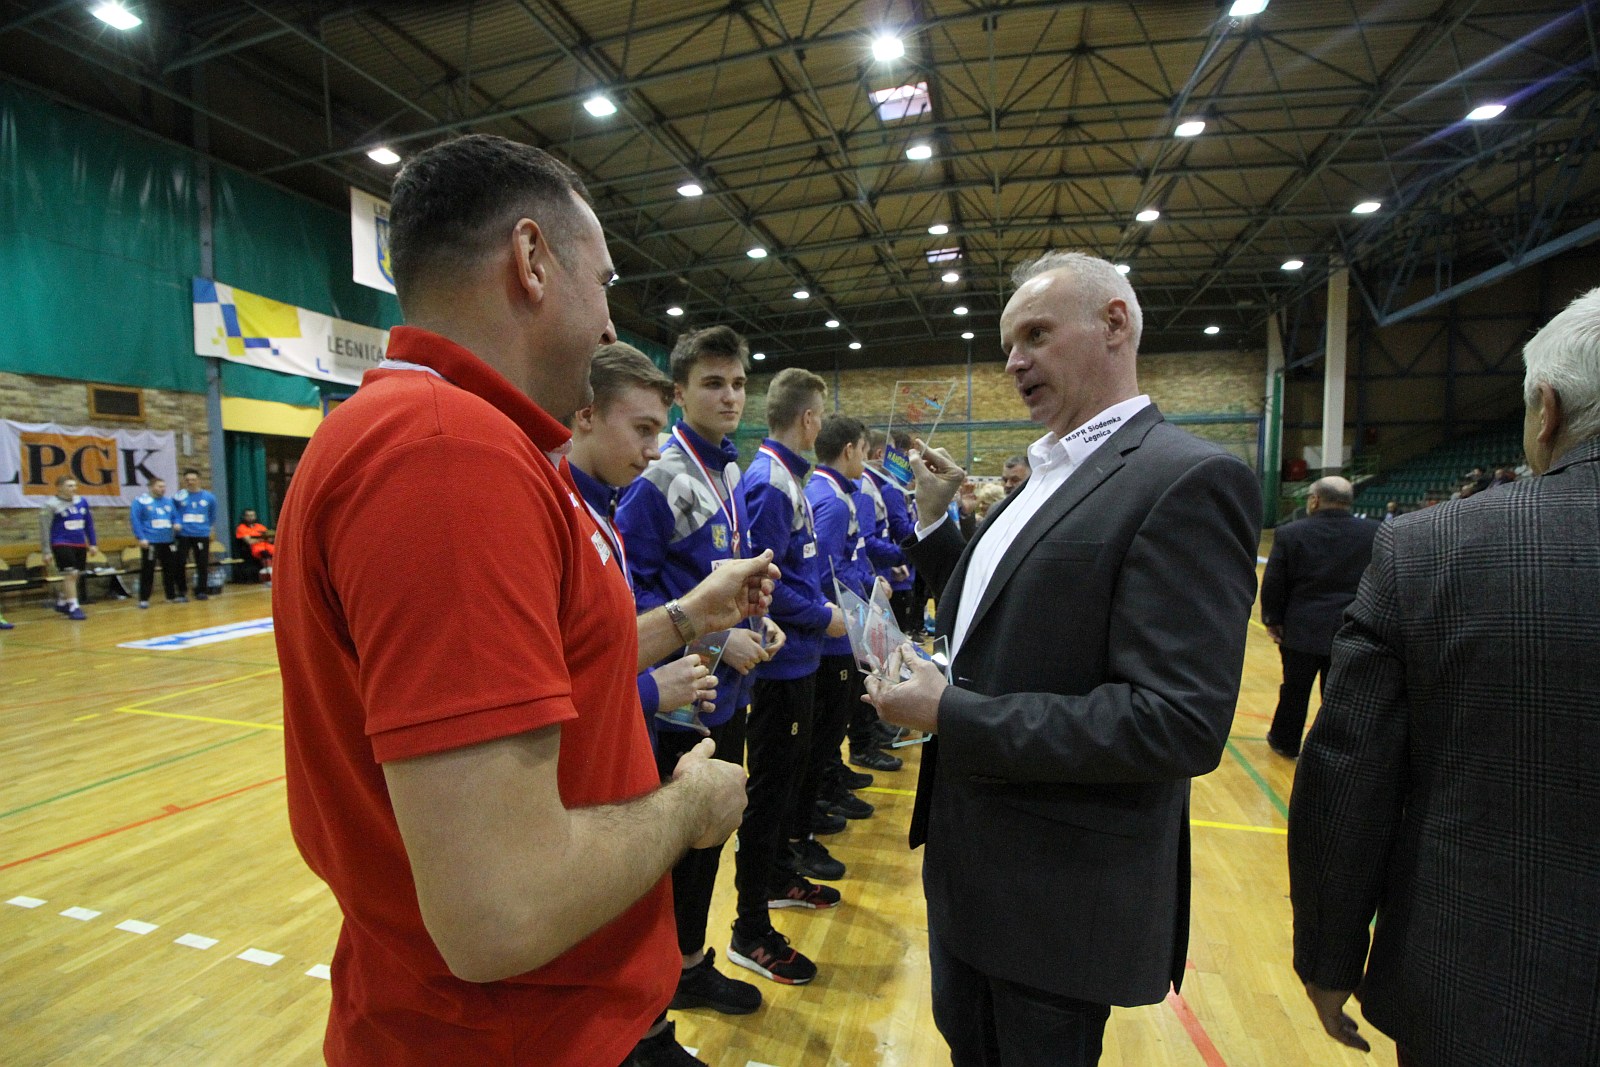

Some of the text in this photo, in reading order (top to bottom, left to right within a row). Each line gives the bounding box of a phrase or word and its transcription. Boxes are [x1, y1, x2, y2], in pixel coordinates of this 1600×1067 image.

[327, 335, 384, 362] LEGNICA
[1065, 429, 1087, 442] MSPR
[1084, 429, 1111, 443] Legnica
[791, 722, 799, 736] 8
